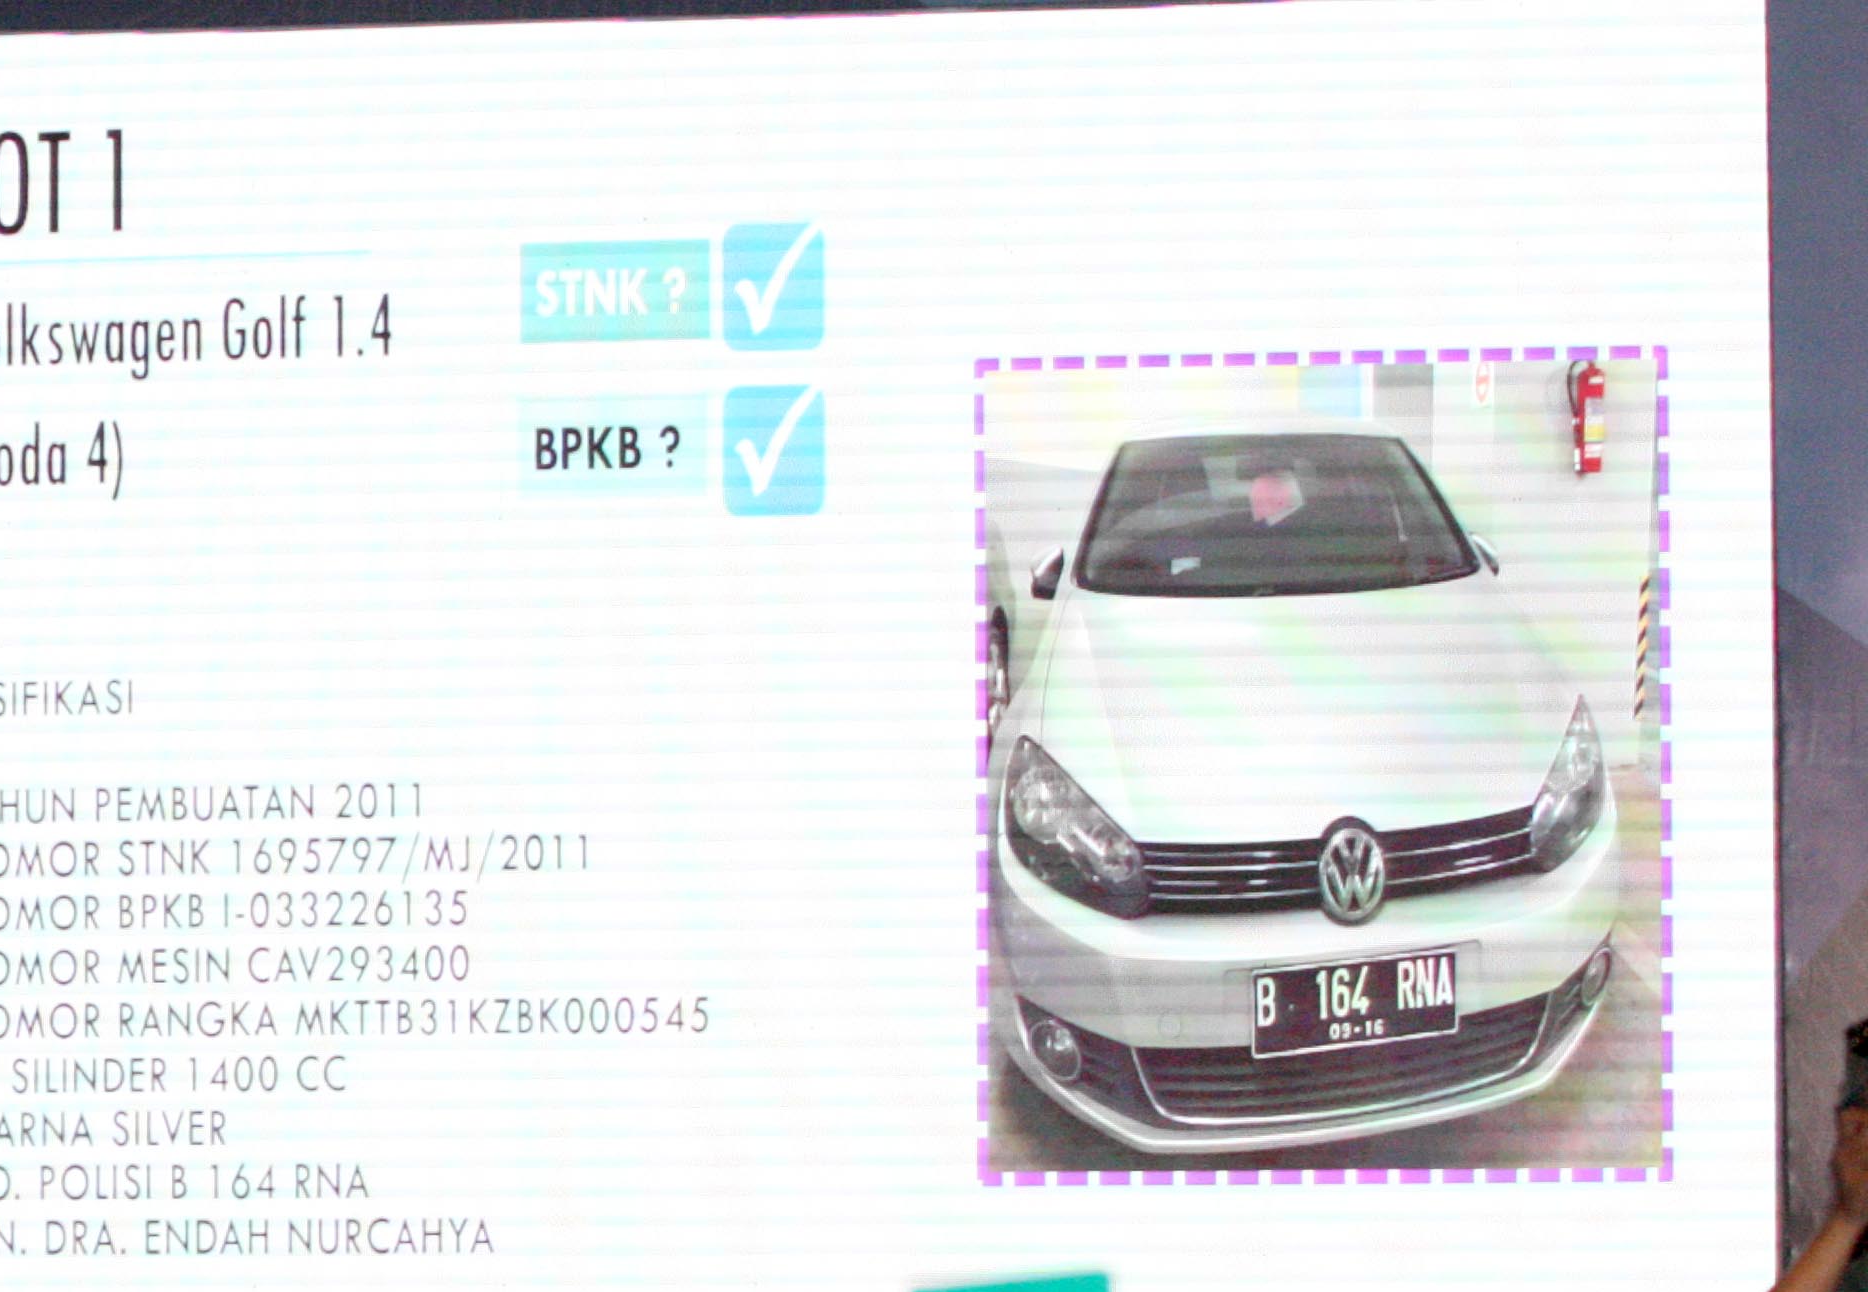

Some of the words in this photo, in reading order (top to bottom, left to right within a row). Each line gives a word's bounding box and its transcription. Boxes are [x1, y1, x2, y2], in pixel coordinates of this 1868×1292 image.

[106, 129, 122, 231] 1
[534, 268, 649, 317] STNK
[223, 295, 306, 360] Golf
[334, 294, 391, 357] 1.4
[87, 421, 123, 500] 4)
[535, 426, 641, 470] BPKB
[97, 786, 313, 821] PEMBUATAN
[335, 783, 423, 819] 2011
[120, 840, 208, 876] STNK
[233, 831, 590, 883] 1695797/MJ/2011
[120, 894, 203, 928] BPKB
[118, 948, 230, 984] MESIN
[249, 945, 468, 983] CAV293400
[1256, 977, 1276, 1027] B
[1316, 965, 1370, 1020] 164
[1397, 956, 1454, 1009] RNA
[120, 1001, 274, 1037] RANGKA
[297, 997, 707, 1035] MKTTB31KZBK000545
[1329, 1019, 1384, 1040] 09-16
[14, 1058, 165, 1093] SILINDER
[191, 1056, 277, 1091] 1400
[297, 1056, 345, 1091] CC
[114, 1111, 225, 1146] SILVER
[41, 1164, 150, 1200] POLISI
[172, 1165, 186, 1199] B
[212, 1165, 274, 1199] 164
[296, 1164, 367, 1197] RNA
[47, 1221, 125, 1255] DRA.
[146, 1220, 268, 1254] ENDAH
[289, 1218, 493, 1254] NURCAHYA
